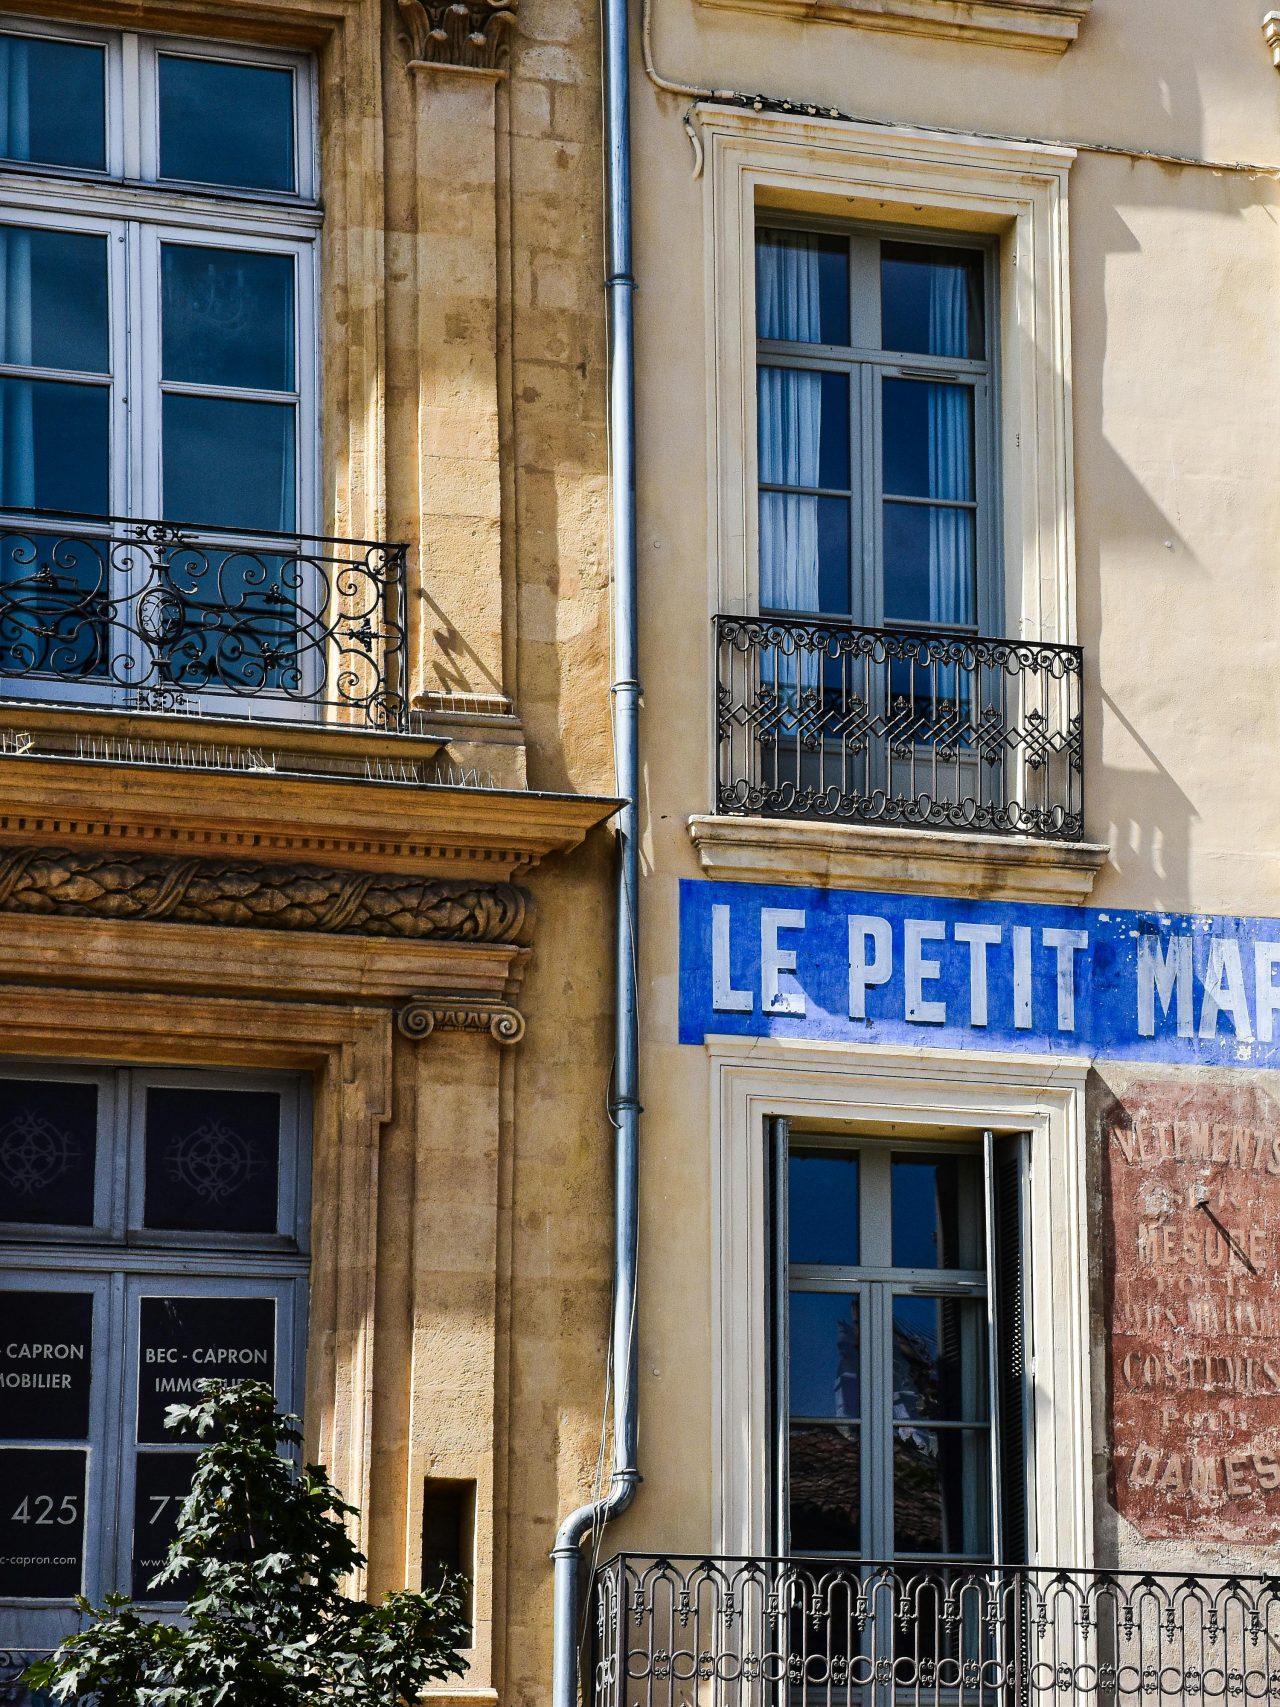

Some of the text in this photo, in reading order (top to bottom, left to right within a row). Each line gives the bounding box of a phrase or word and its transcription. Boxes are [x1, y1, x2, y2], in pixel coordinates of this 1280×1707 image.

[712, 904, 806, 1017] LE
[848, 914, 1089, 1031] PETIT
[6, 1343, 84, 1360] CAPRON
[145, 1348, 178, 1363] BEC
[192, 1348, 268, 1364] CAPRON
[11, 1495, 78, 1525] 425
